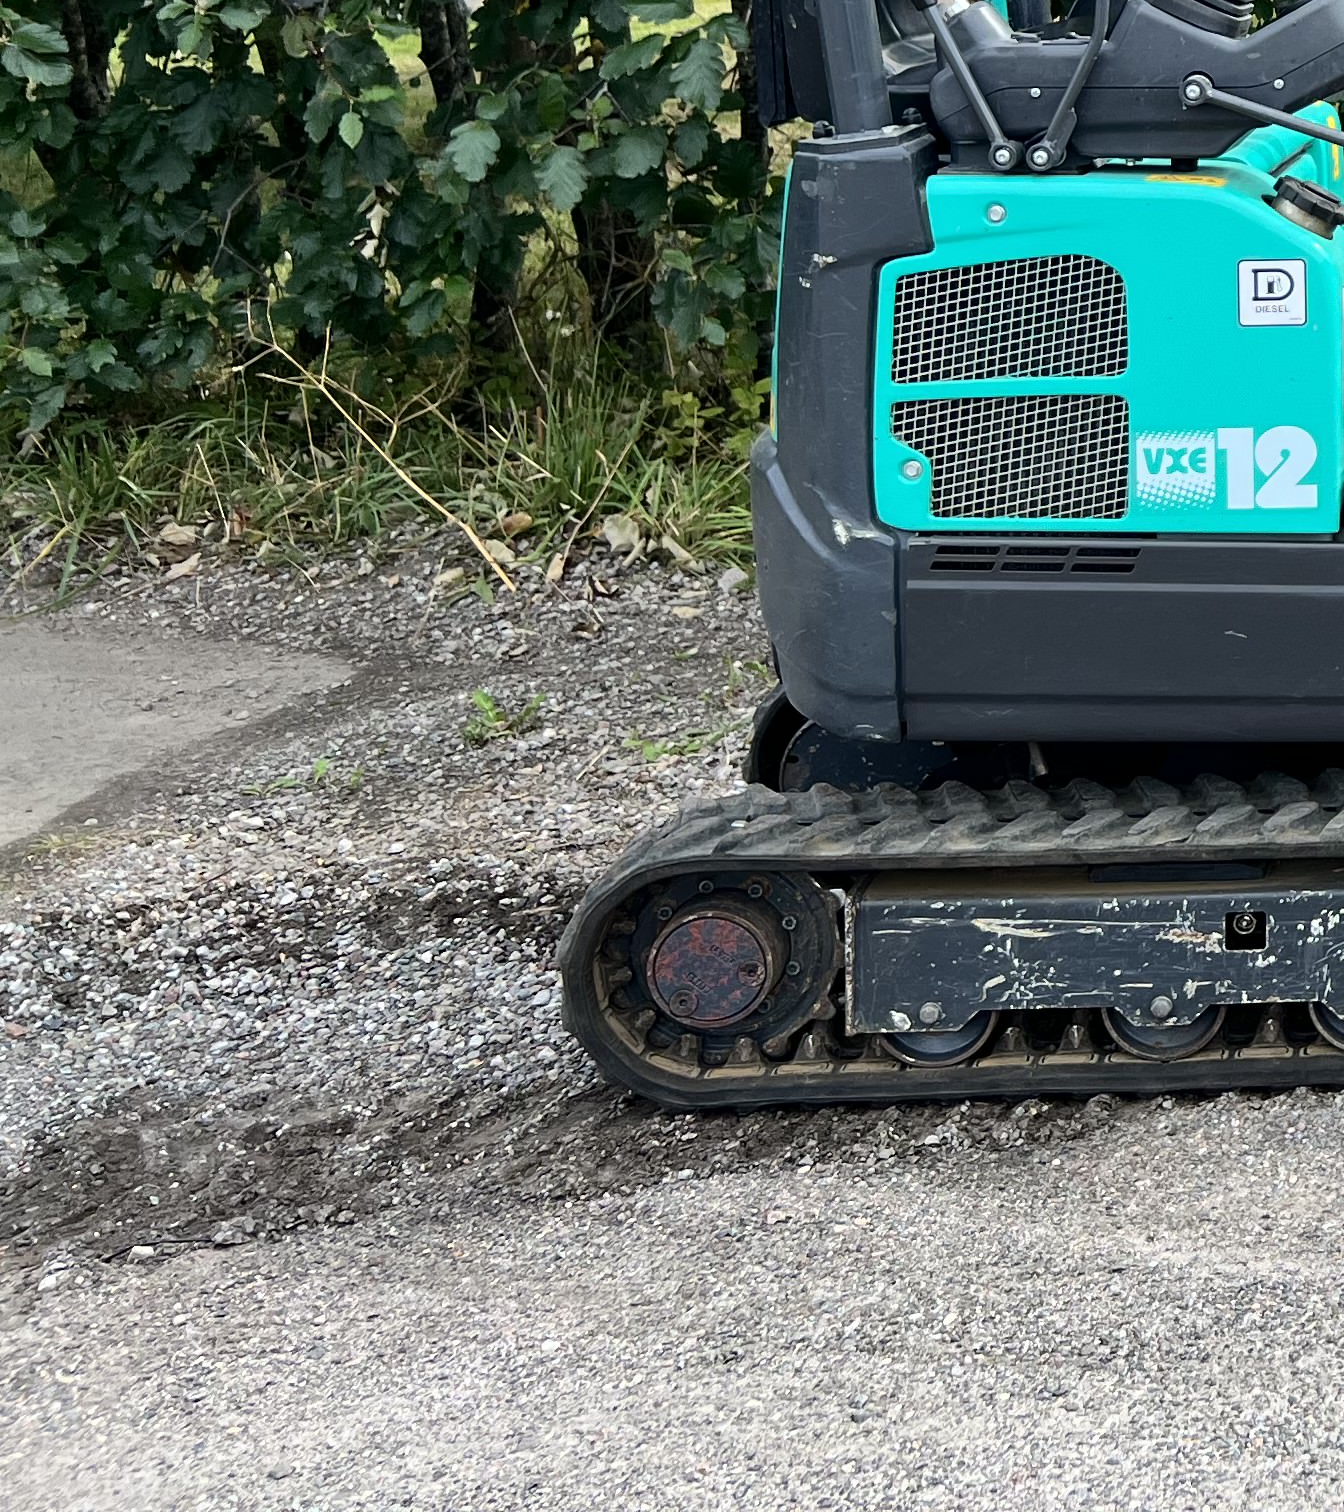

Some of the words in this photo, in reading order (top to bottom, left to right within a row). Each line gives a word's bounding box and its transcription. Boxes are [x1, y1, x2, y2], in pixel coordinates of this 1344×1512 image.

[1255, 304, 1290, 313] DIESEL
[1143, 447, 1207, 475] VXE
[1217, 425, 1319, 510] 12
